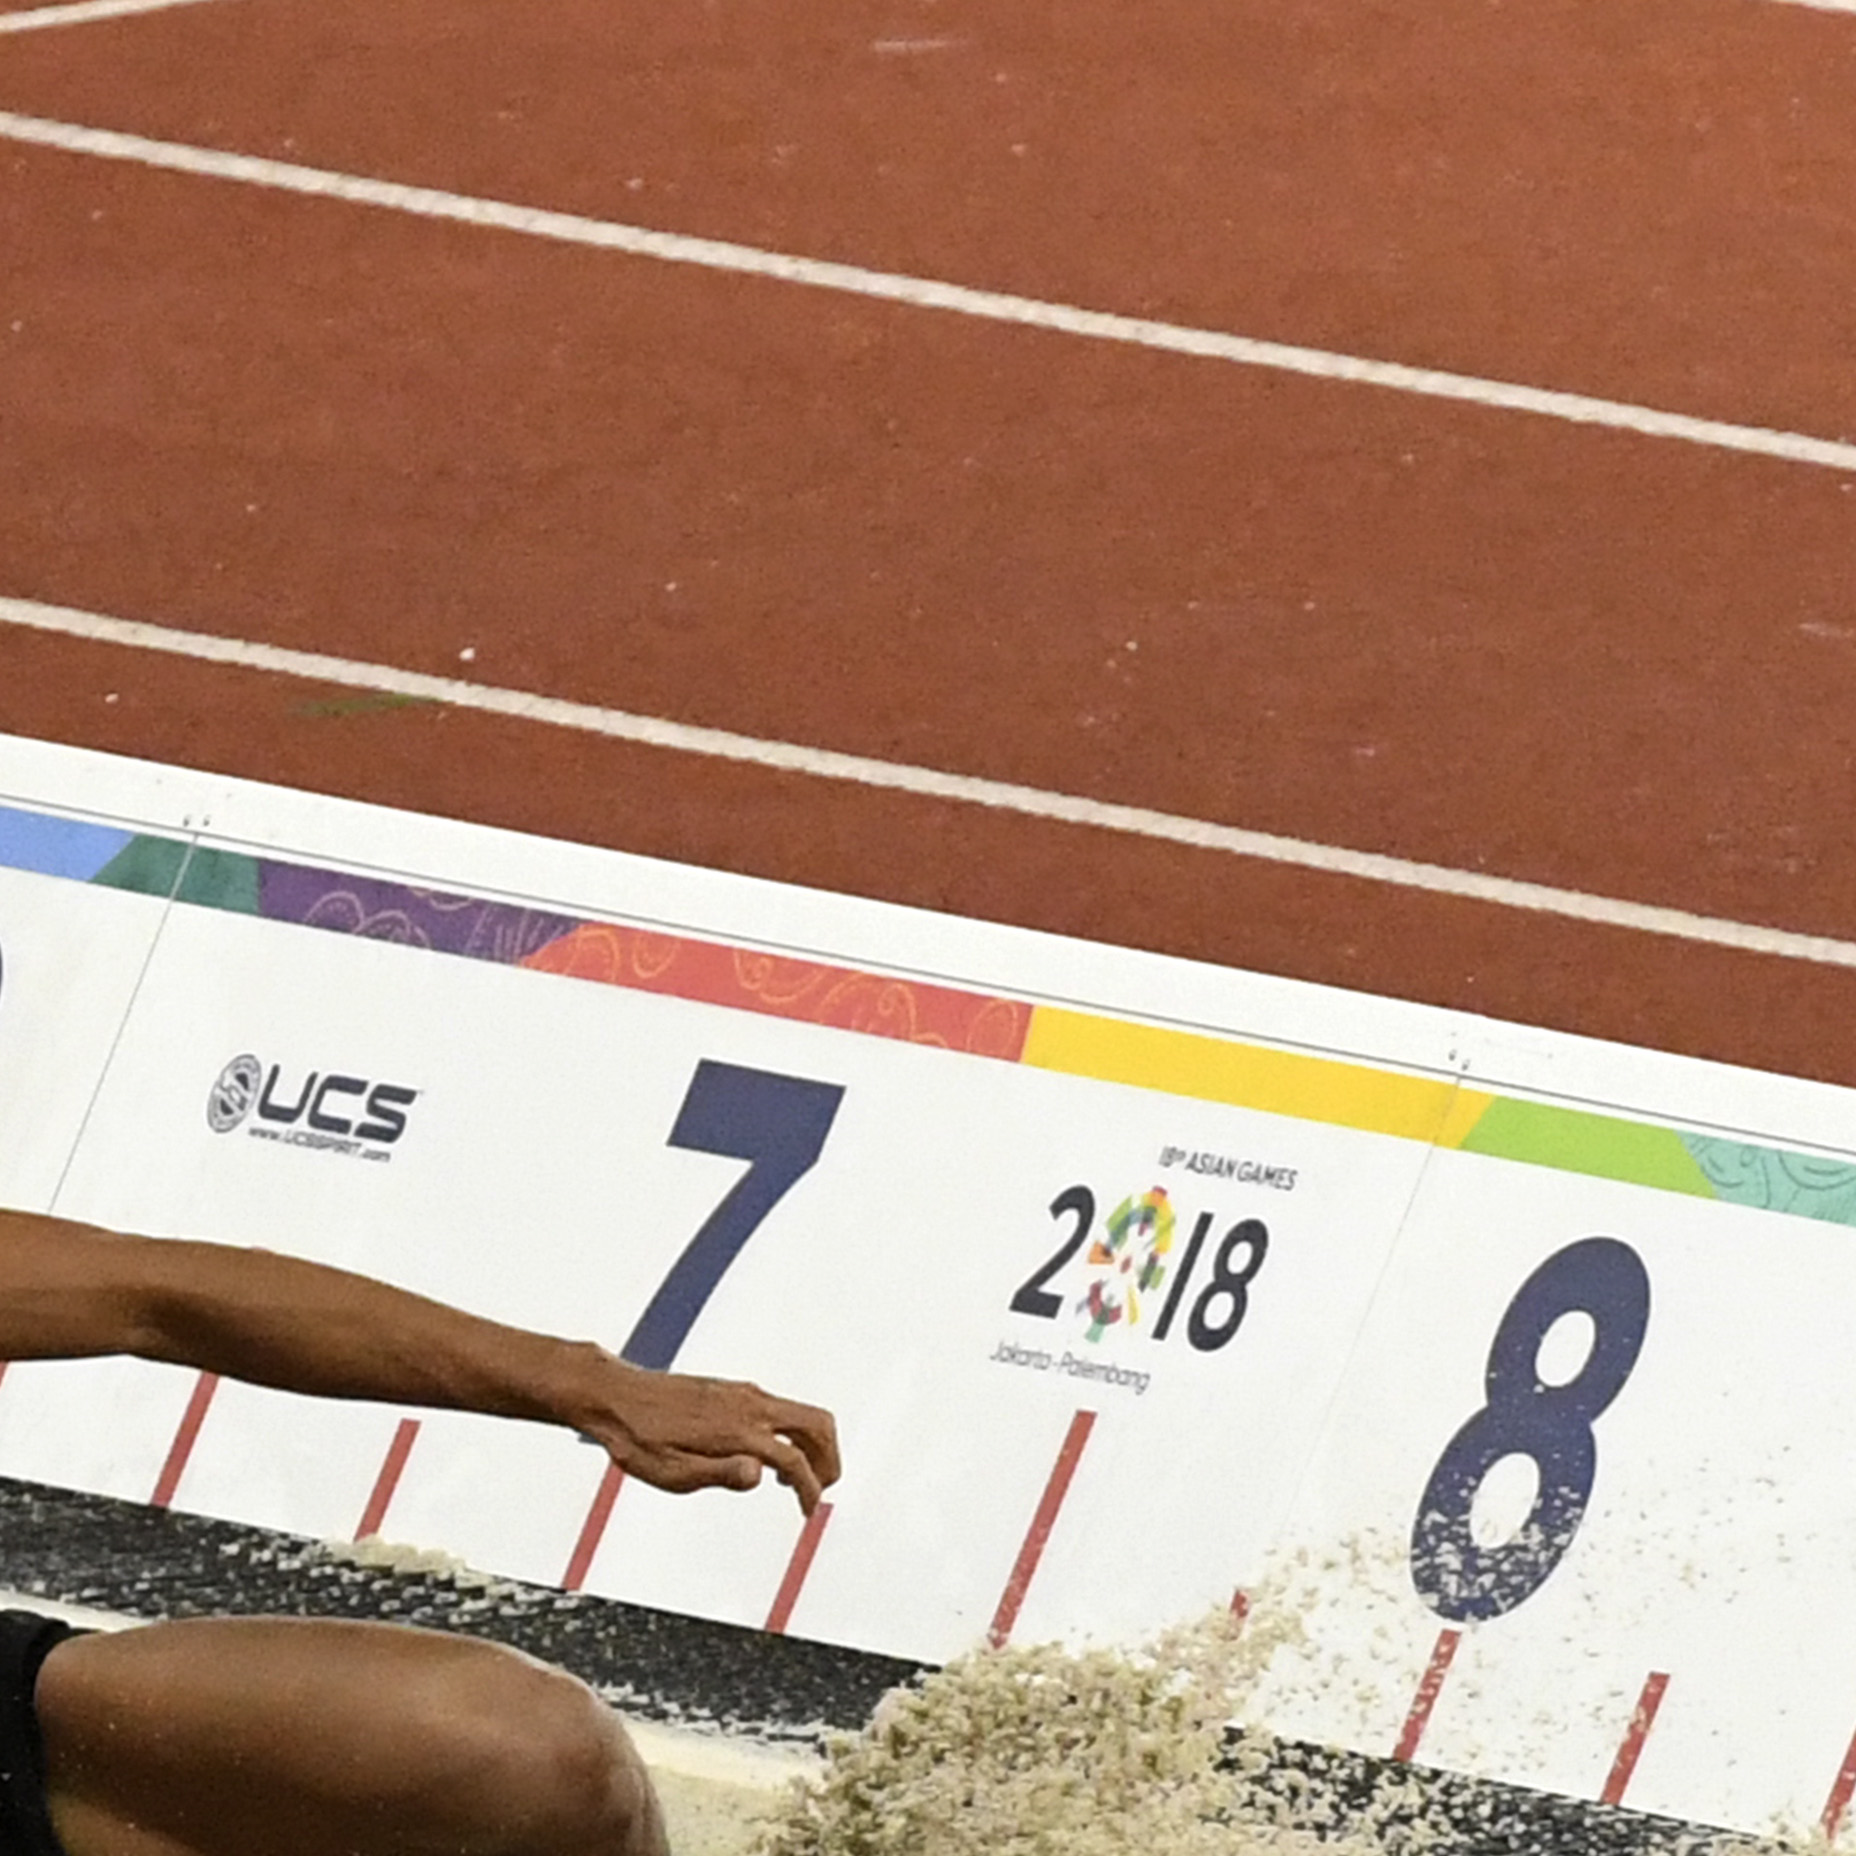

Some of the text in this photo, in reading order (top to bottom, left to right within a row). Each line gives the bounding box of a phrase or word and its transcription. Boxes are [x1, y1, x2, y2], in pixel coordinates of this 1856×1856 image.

[258, 1064, 417, 1144] UCS
[1184, 1151, 1239, 1179] ASIAN
[1236, 1160, 1298, 1192] GAMES
[578, 1058, 846, 1442] 7
[1410, 1237, 1650, 1622] 8
